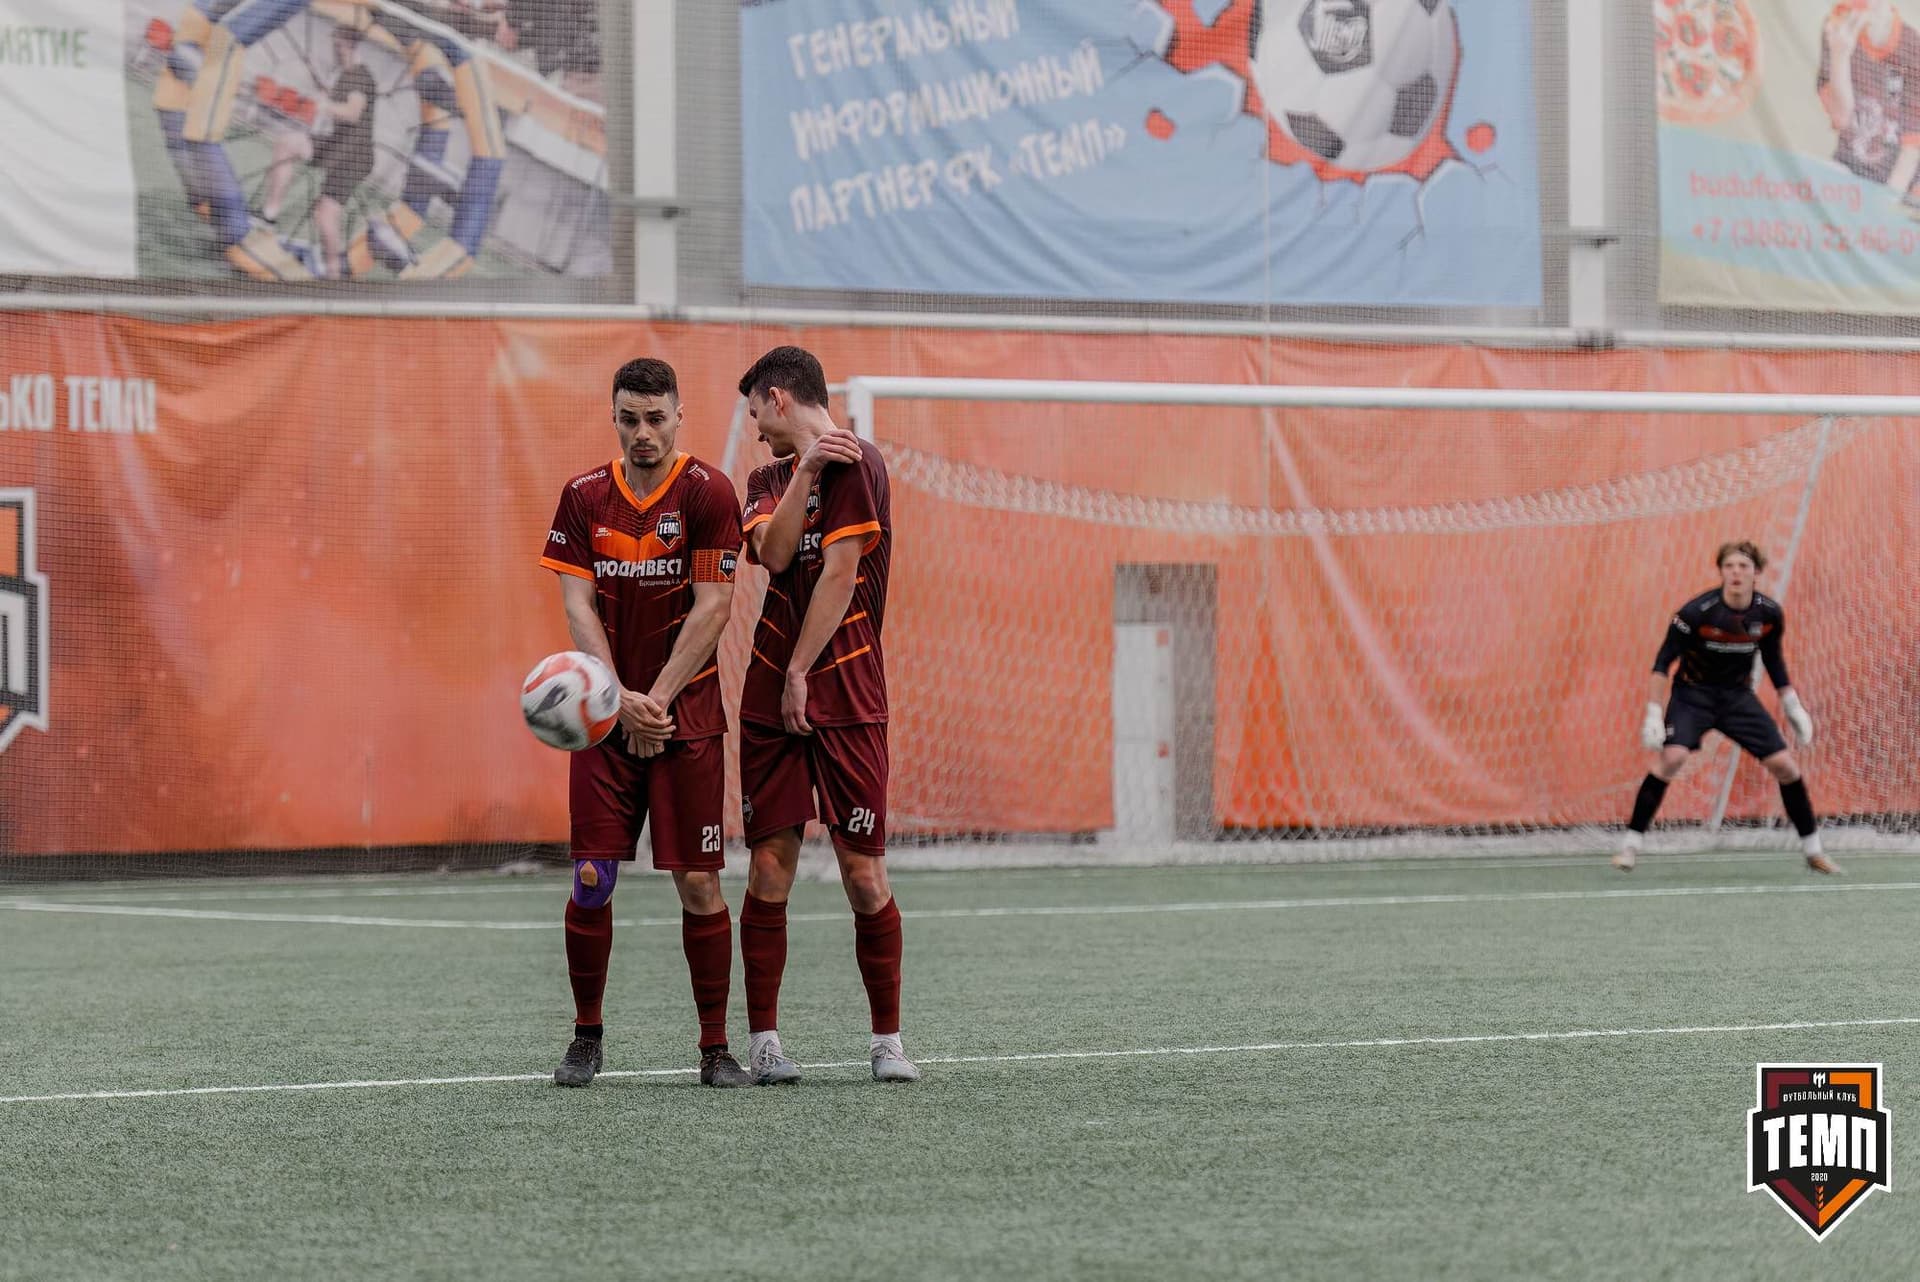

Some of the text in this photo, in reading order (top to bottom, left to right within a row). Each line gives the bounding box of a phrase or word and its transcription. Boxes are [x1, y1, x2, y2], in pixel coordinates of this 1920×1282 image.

[790, 38, 1104, 161] ИНФОРМАЦИОННЫЙ
[790, 159, 938, 233] ПАРТНЕР
[944, 144, 1002, 193] ФК
[702, 824, 721, 853] 23
[847, 807, 876, 836] 24
